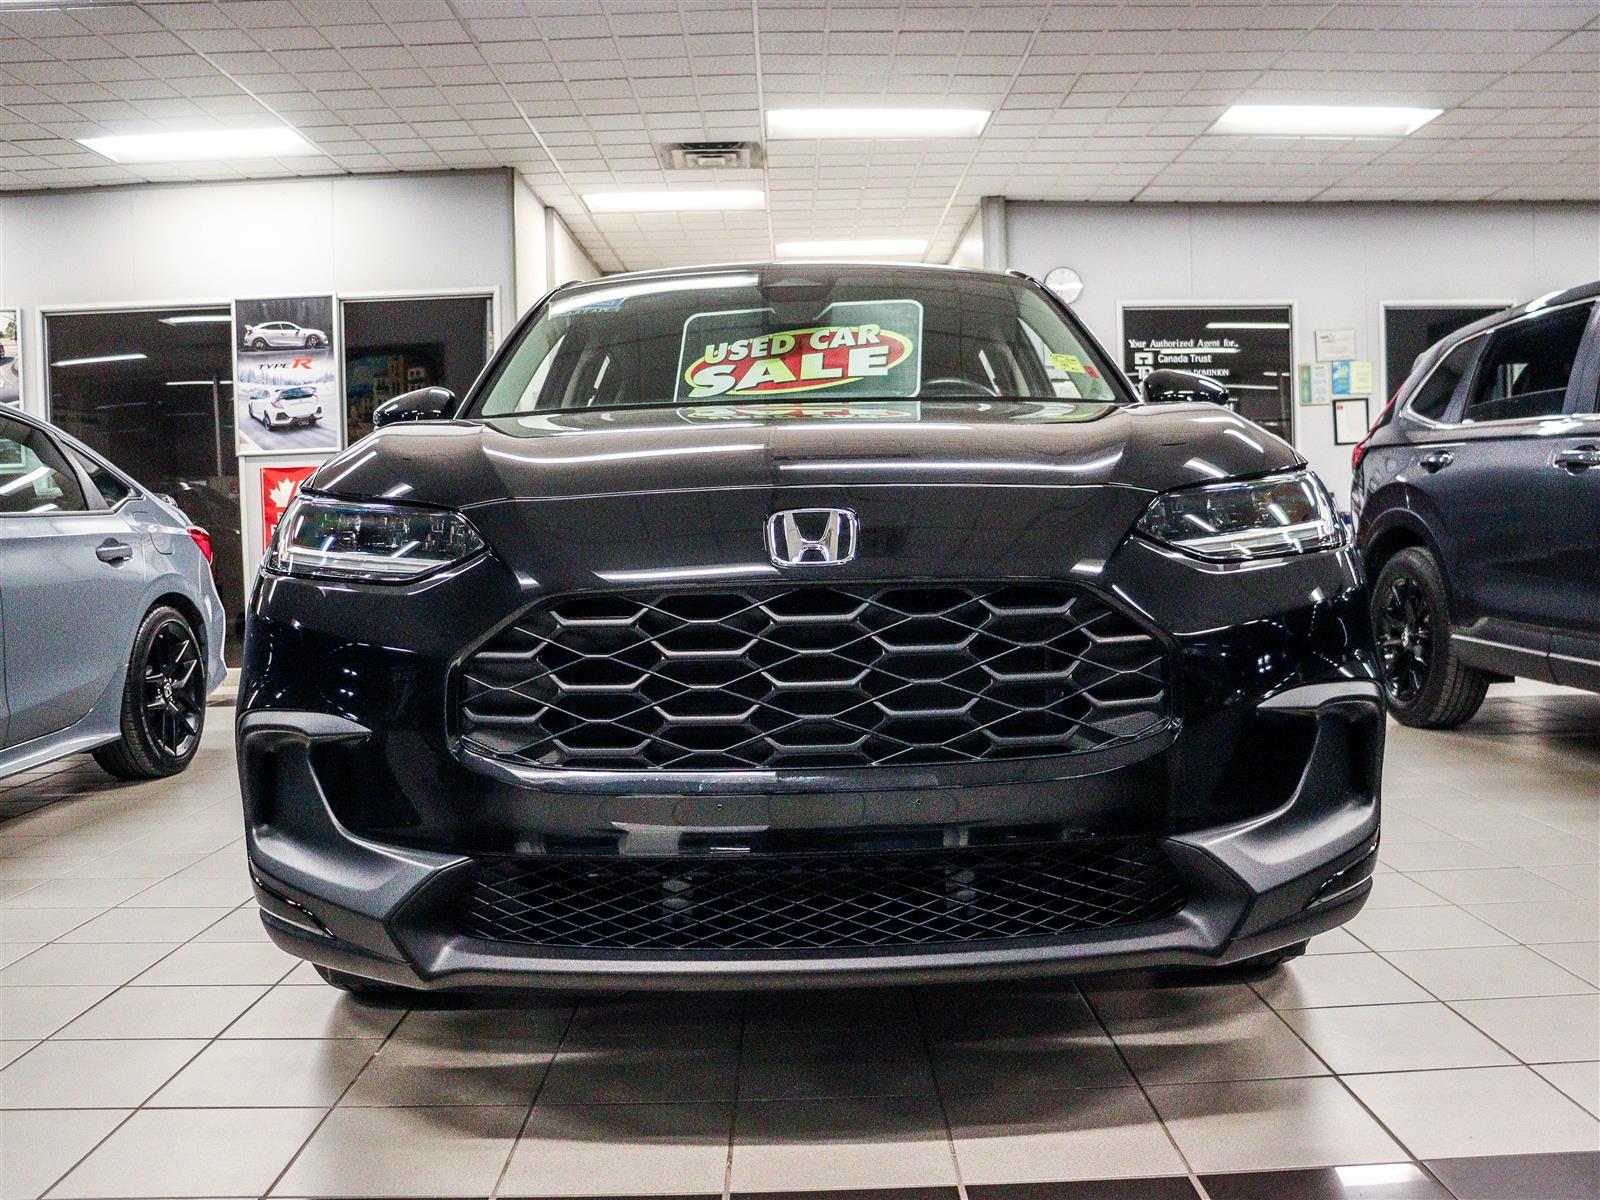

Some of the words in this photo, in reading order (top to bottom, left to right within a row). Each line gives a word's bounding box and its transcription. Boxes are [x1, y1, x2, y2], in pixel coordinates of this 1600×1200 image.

[704, 334, 795, 364] USED
[809, 323, 881, 350] CAR
[1128, 339, 1146, 348] Your
[1150, 339, 1193, 348] Authorized
[1197, 339, 1220, 348] Agent
[292, 357, 312, 369] R
[1157, 354, 1188, 363] Canada
[1190, 354, 1212, 363] Trust
[688, 345, 889, 398] SALE
